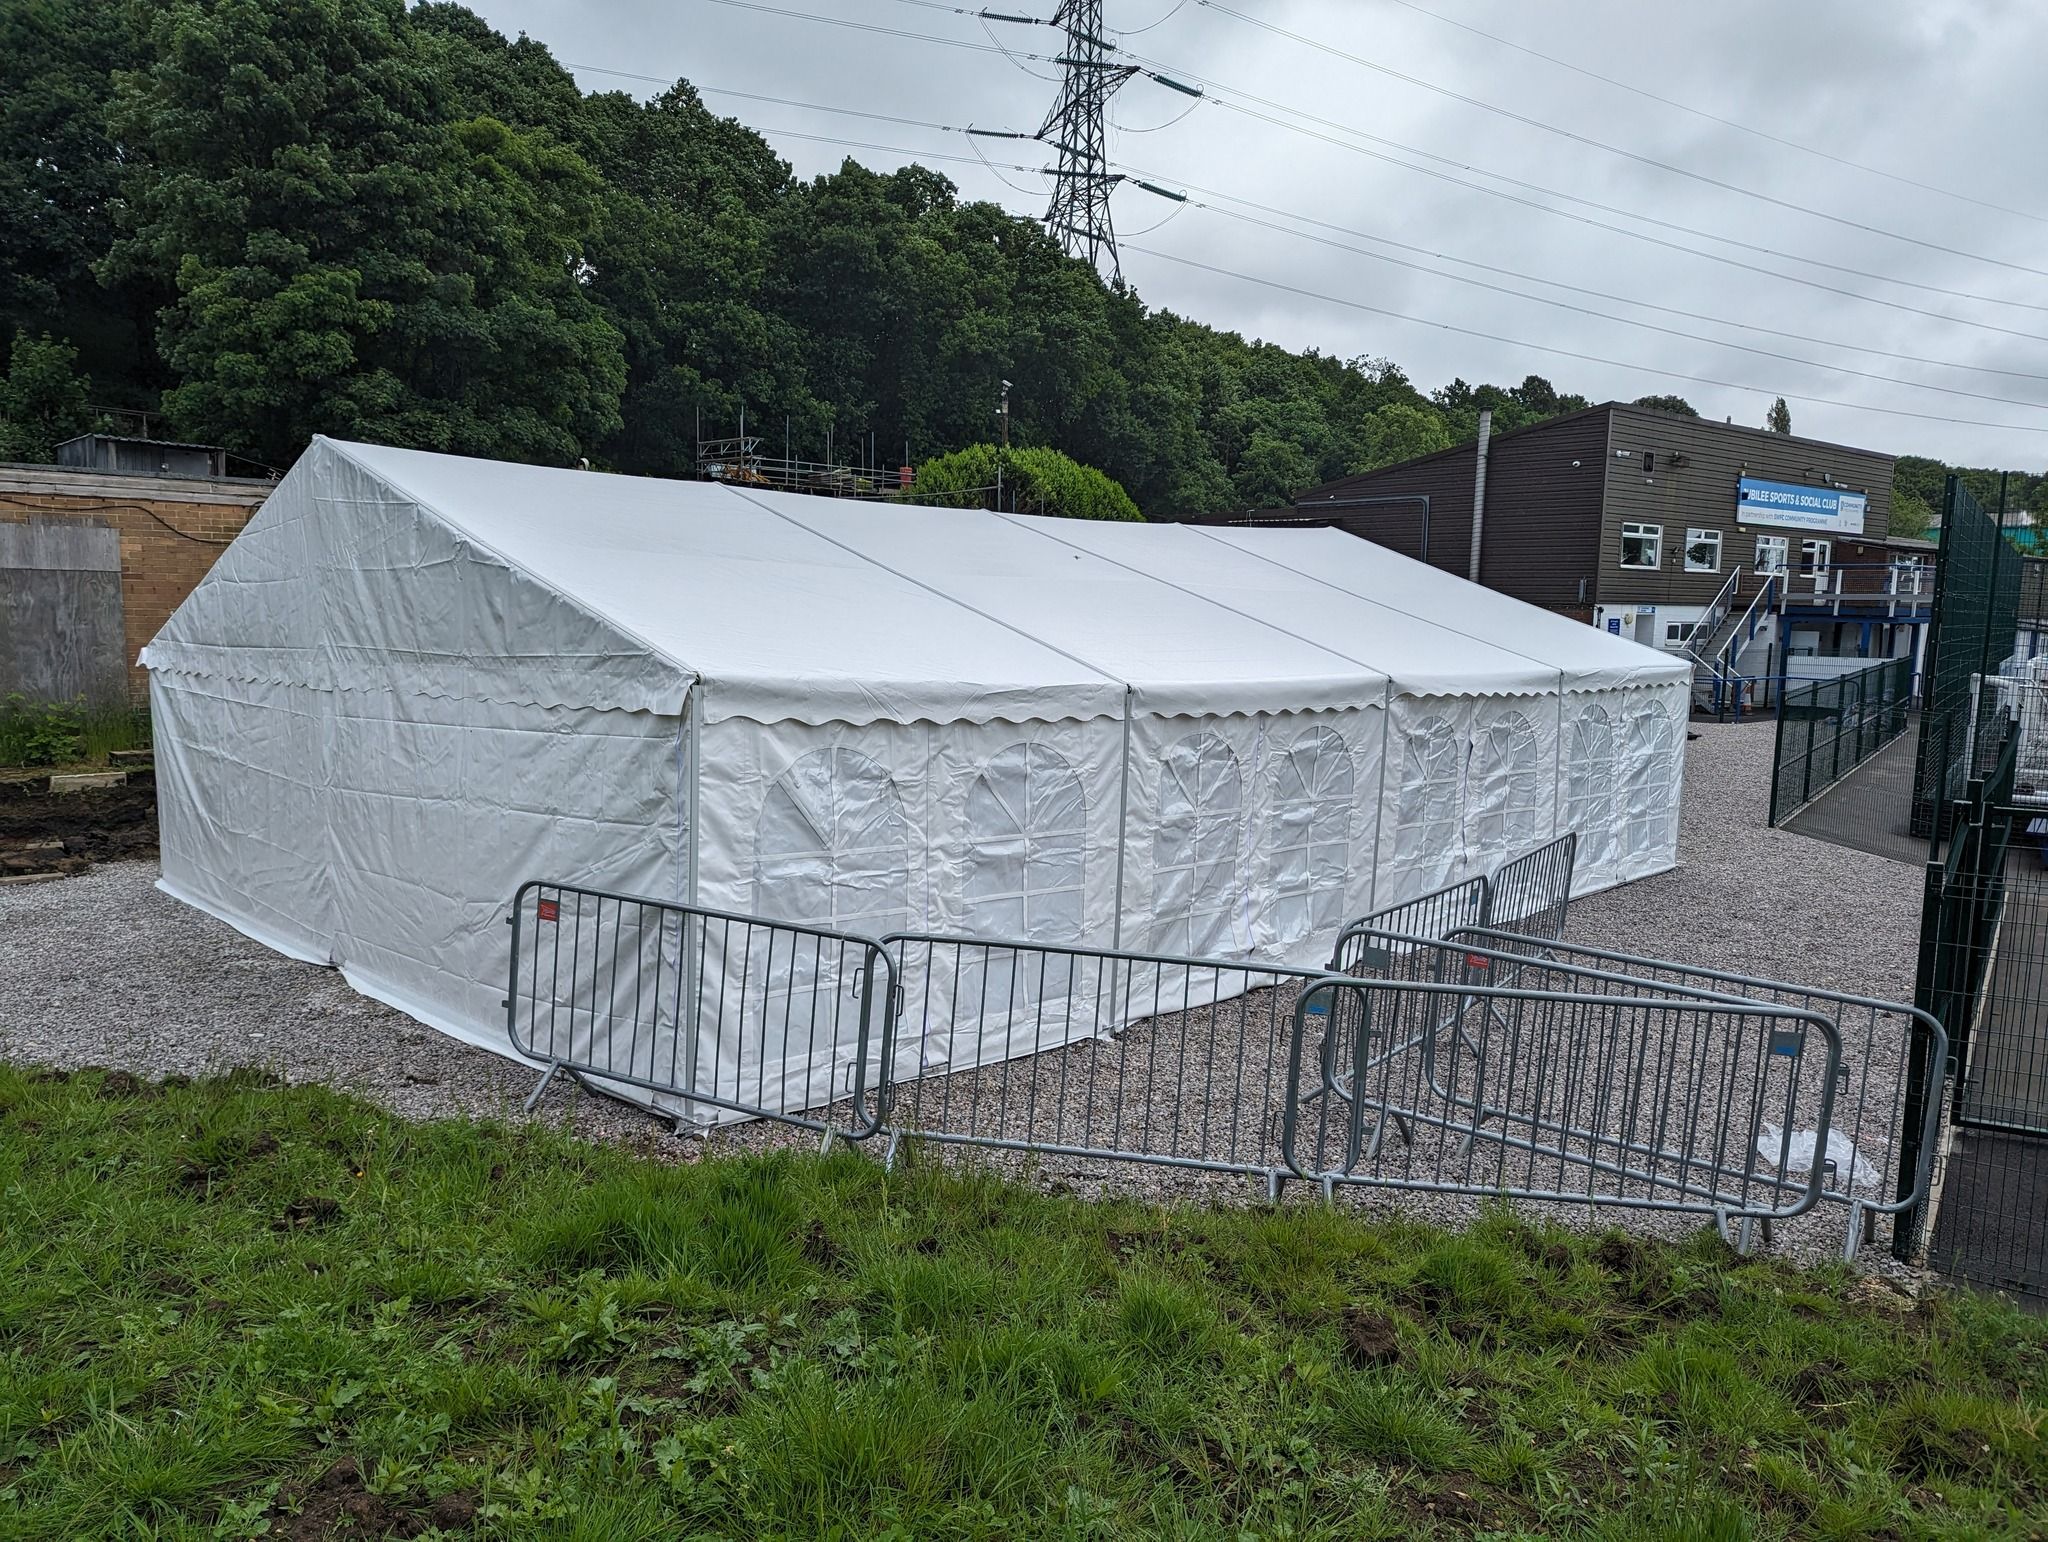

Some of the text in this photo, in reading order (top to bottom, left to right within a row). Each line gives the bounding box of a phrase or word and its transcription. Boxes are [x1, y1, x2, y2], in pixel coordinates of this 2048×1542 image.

[1769, 491, 1795, 505] SPORTS
[1795, 494, 1800, 505] &
[1800, 495, 1822, 509] SOCIAL
[1822, 498, 1838, 510] CLUB
